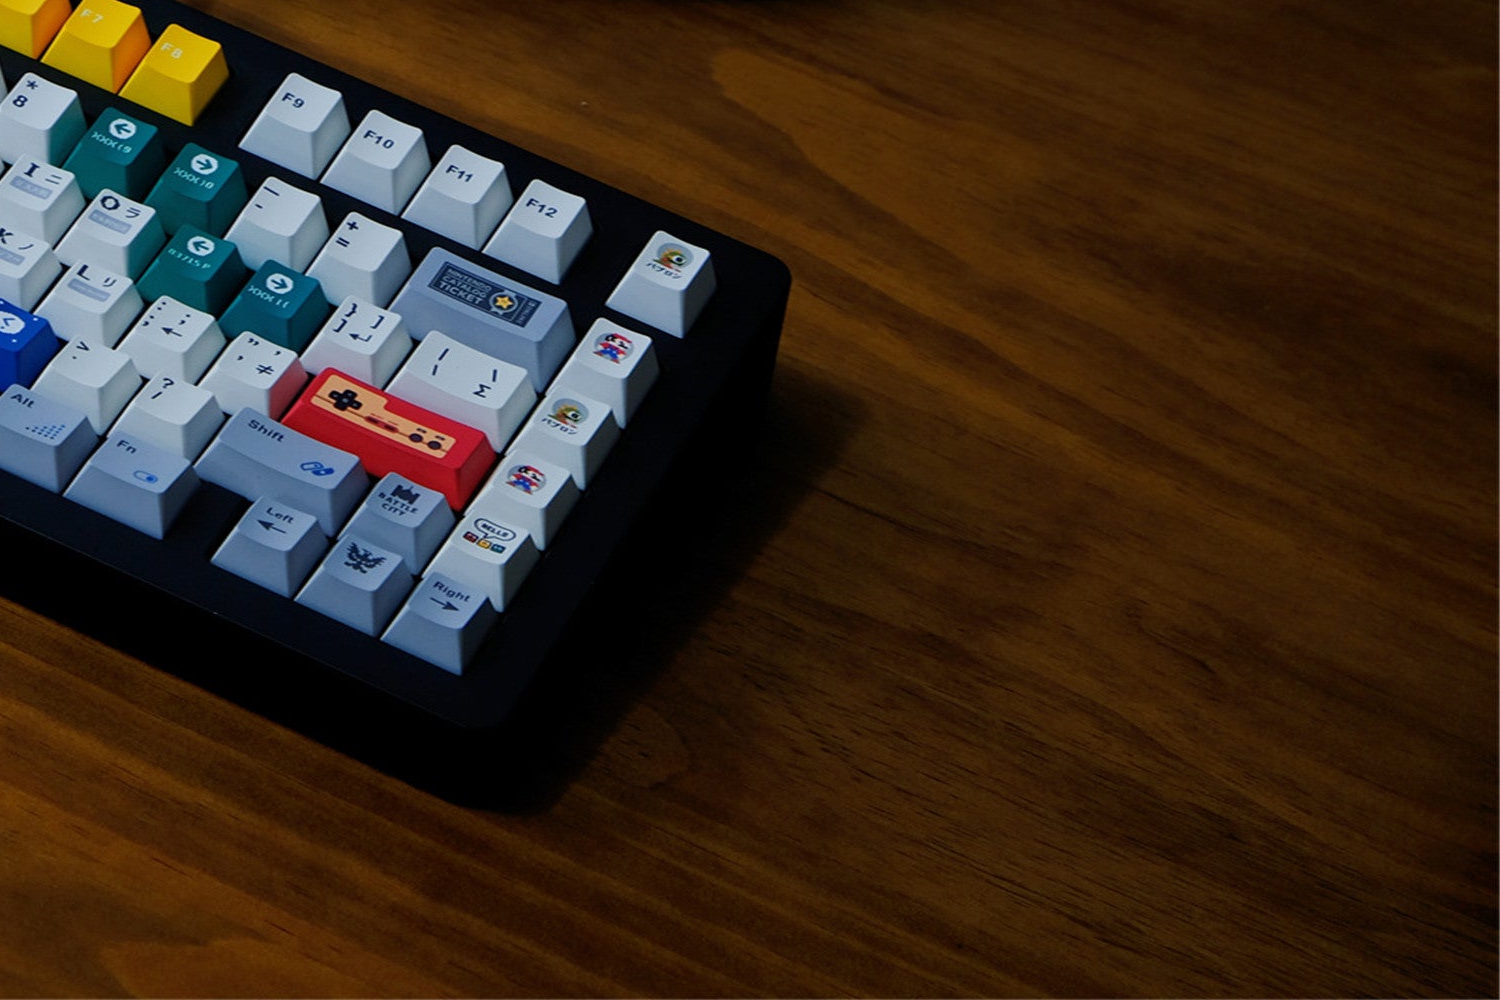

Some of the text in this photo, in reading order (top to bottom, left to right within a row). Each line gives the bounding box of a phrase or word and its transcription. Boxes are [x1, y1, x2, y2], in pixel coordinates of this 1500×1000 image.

[79, 7, 104, 24] F7
[160, 41, 184, 59] F8
[12, 94, 28, 108] 8
[280, 91, 305, 109] F9
[363, 129, 396, 151] F10
[23, 162, 41, 178] I
[445, 163, 474, 184] F11
[100, 195, 121, 212] O
[525, 197, 558, 220] F12
[76, 264, 91, 281] L
[436, 280, 484, 305] TICKET
[440, 274, 488, 298] CATALOG
[161, 377, 175, 389] ?
[9, 393, 35, 409] Alt
[247, 419, 285, 443] Shift
[116, 440, 138, 455] Fn
[378, 491, 419, 515] BATTLE
[381, 503, 407, 517] CITY
[265, 506, 295, 525] Left
[432, 581, 471, 603] Right
